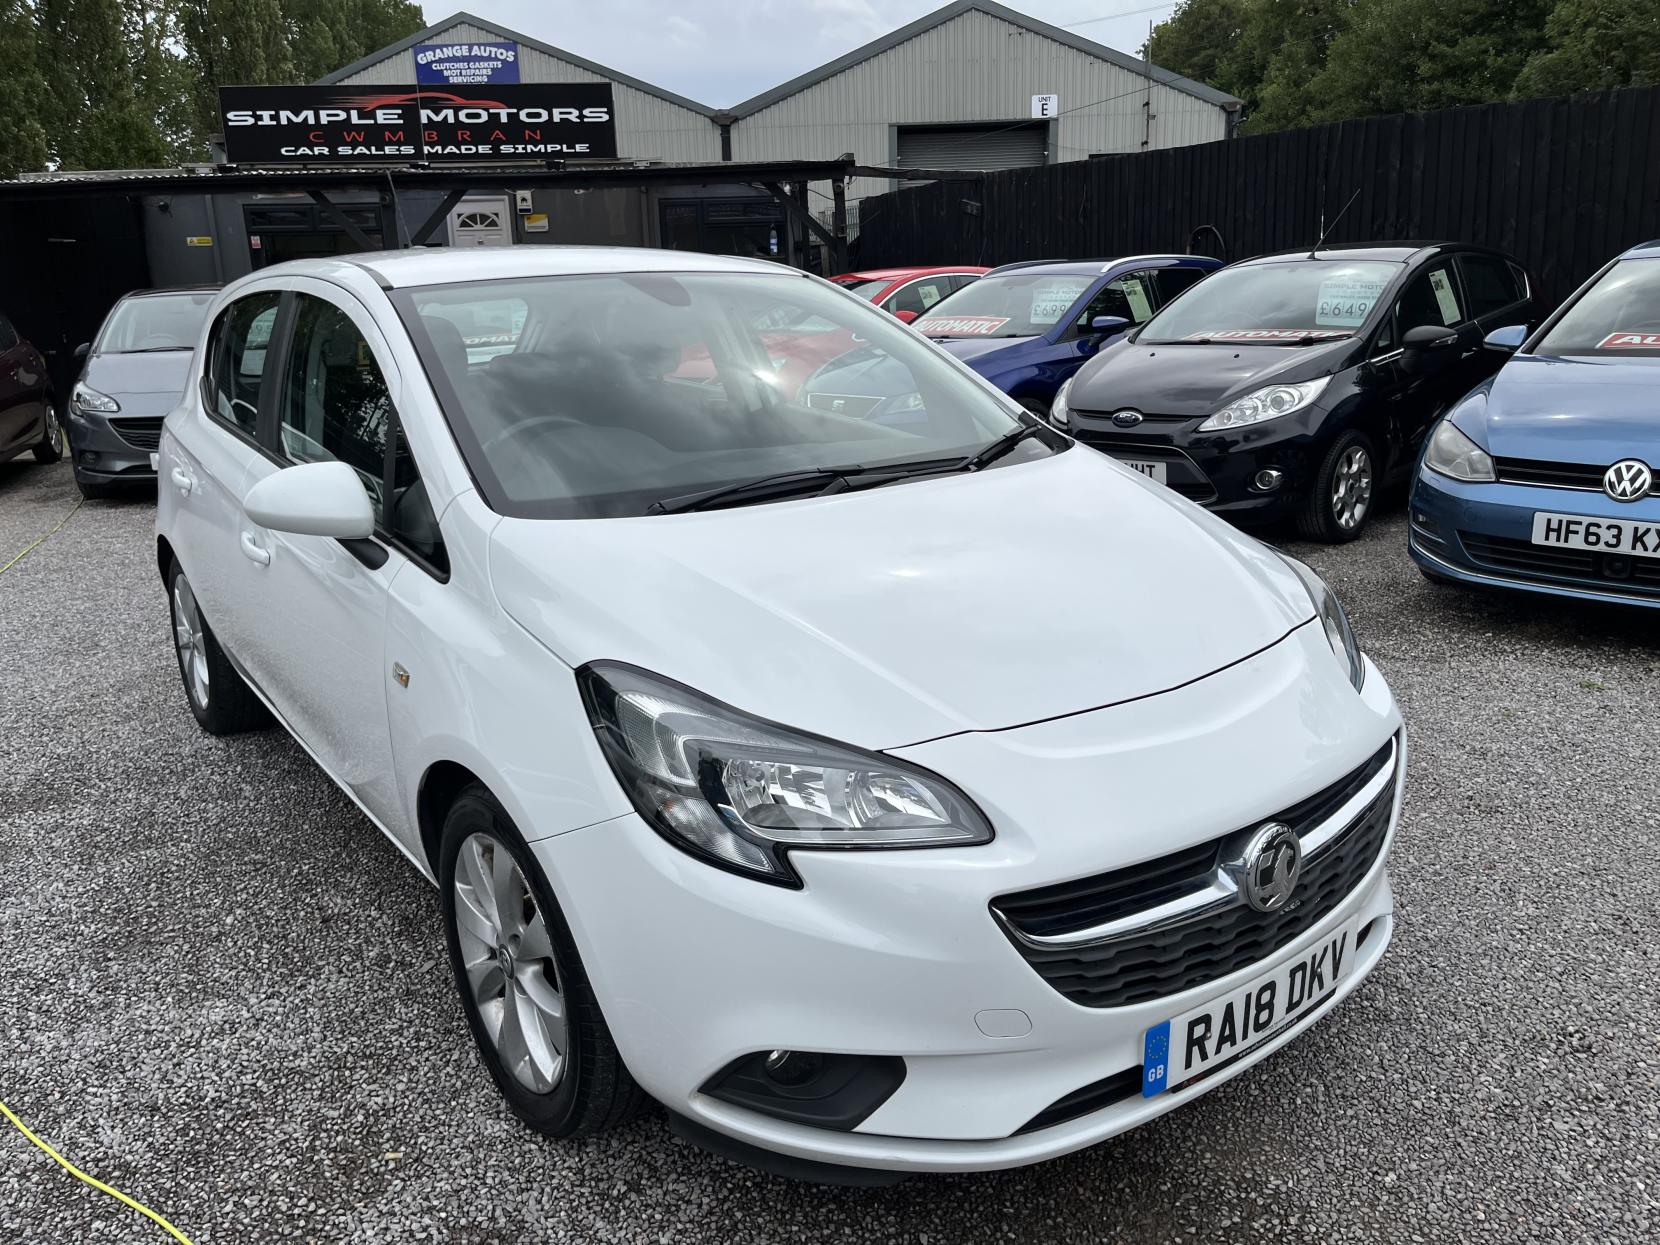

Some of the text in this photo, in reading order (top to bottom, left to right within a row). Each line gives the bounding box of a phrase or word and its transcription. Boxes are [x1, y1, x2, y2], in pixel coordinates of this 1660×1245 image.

[417, 45, 515, 64] GRANGE AUTOS
[432, 61, 502, 70] CLUTCHES GASKETS
[461, 68, 492, 76] REPAIRS
[449, 75, 488, 83] SERVICING
[226, 107, 610, 126] SIMPLE MOTORS
[1041, 103, 1048, 116] E
[309, 129, 542, 143] CWMBRAN
[280, 144, 590, 156] CAR SALES MADE SIMPLE
[1544, 518, 1623, 549] HF63
[1184, 980, 1277, 1070] RA18
[1285, 931, 1348, 1015] DKV
[1147, 1064, 1165, 1083] GB
